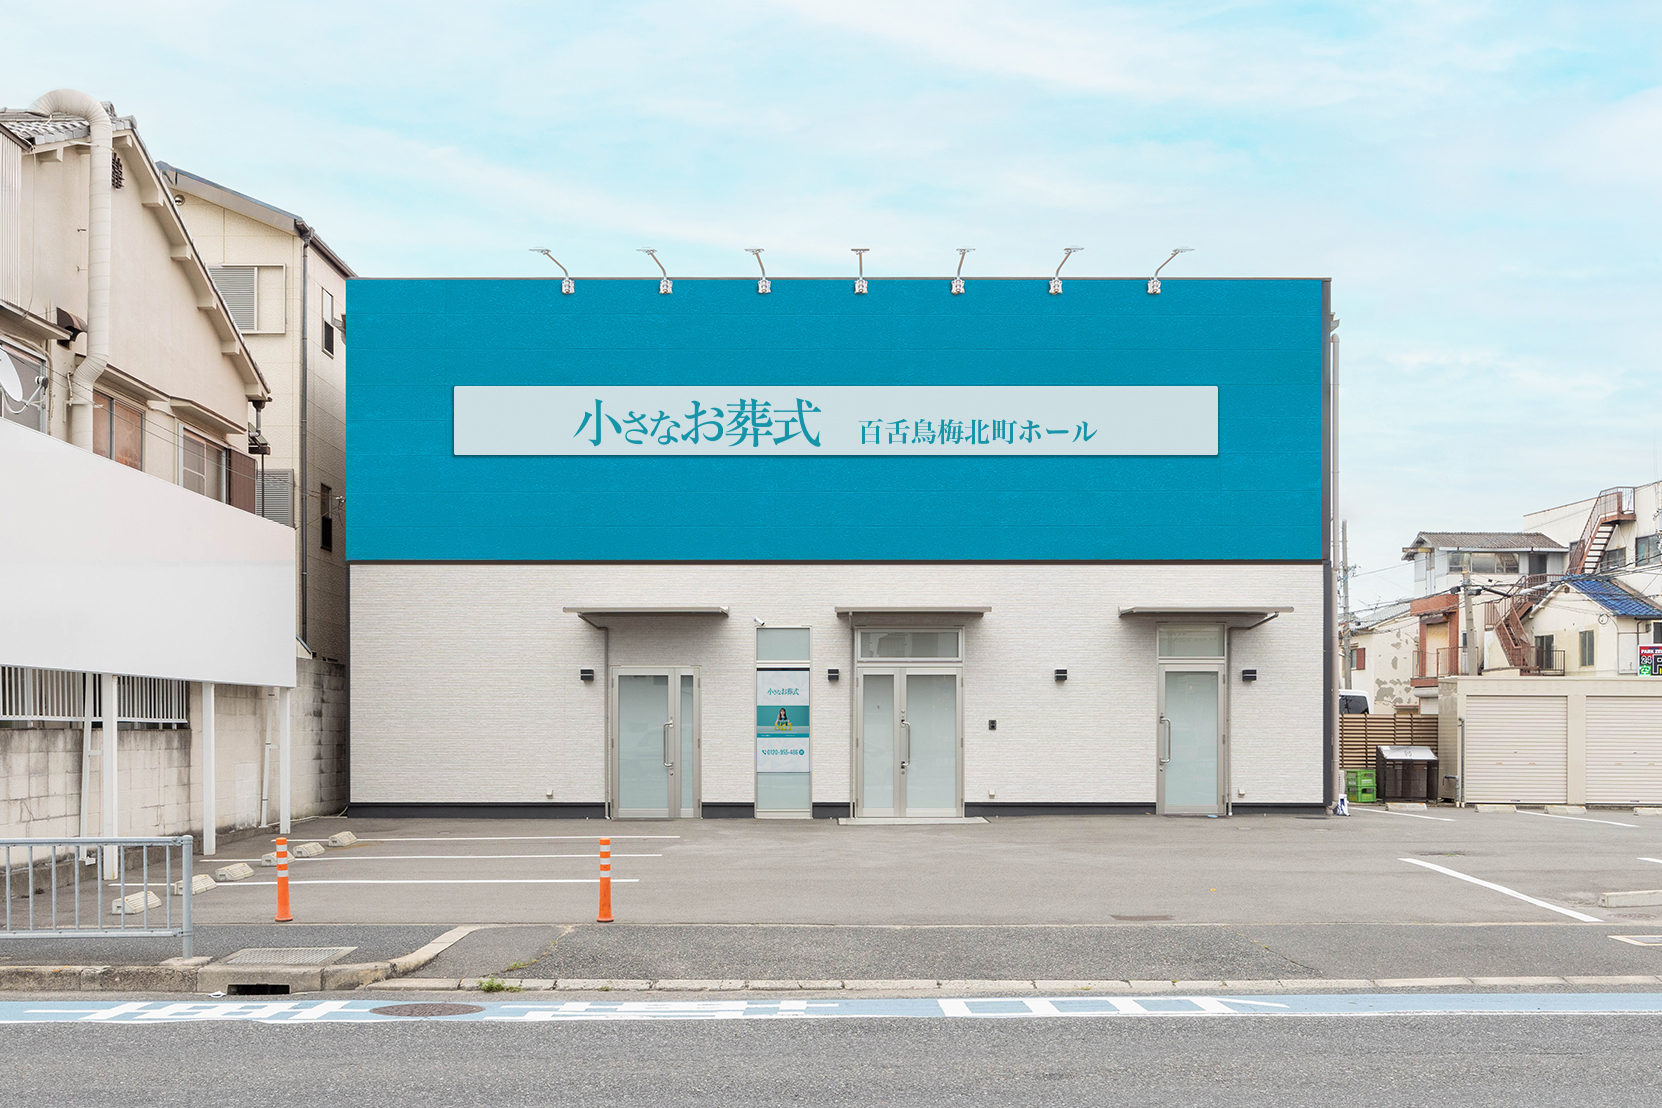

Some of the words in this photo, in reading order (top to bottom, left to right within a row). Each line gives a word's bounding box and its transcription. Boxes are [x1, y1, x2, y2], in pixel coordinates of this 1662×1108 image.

[573, 397, 822, 448] 小さなお葬式
[858, 418, 1098, 445] 百舌鳥梅北町ホール
[774, 722, 792, 731] No.1
